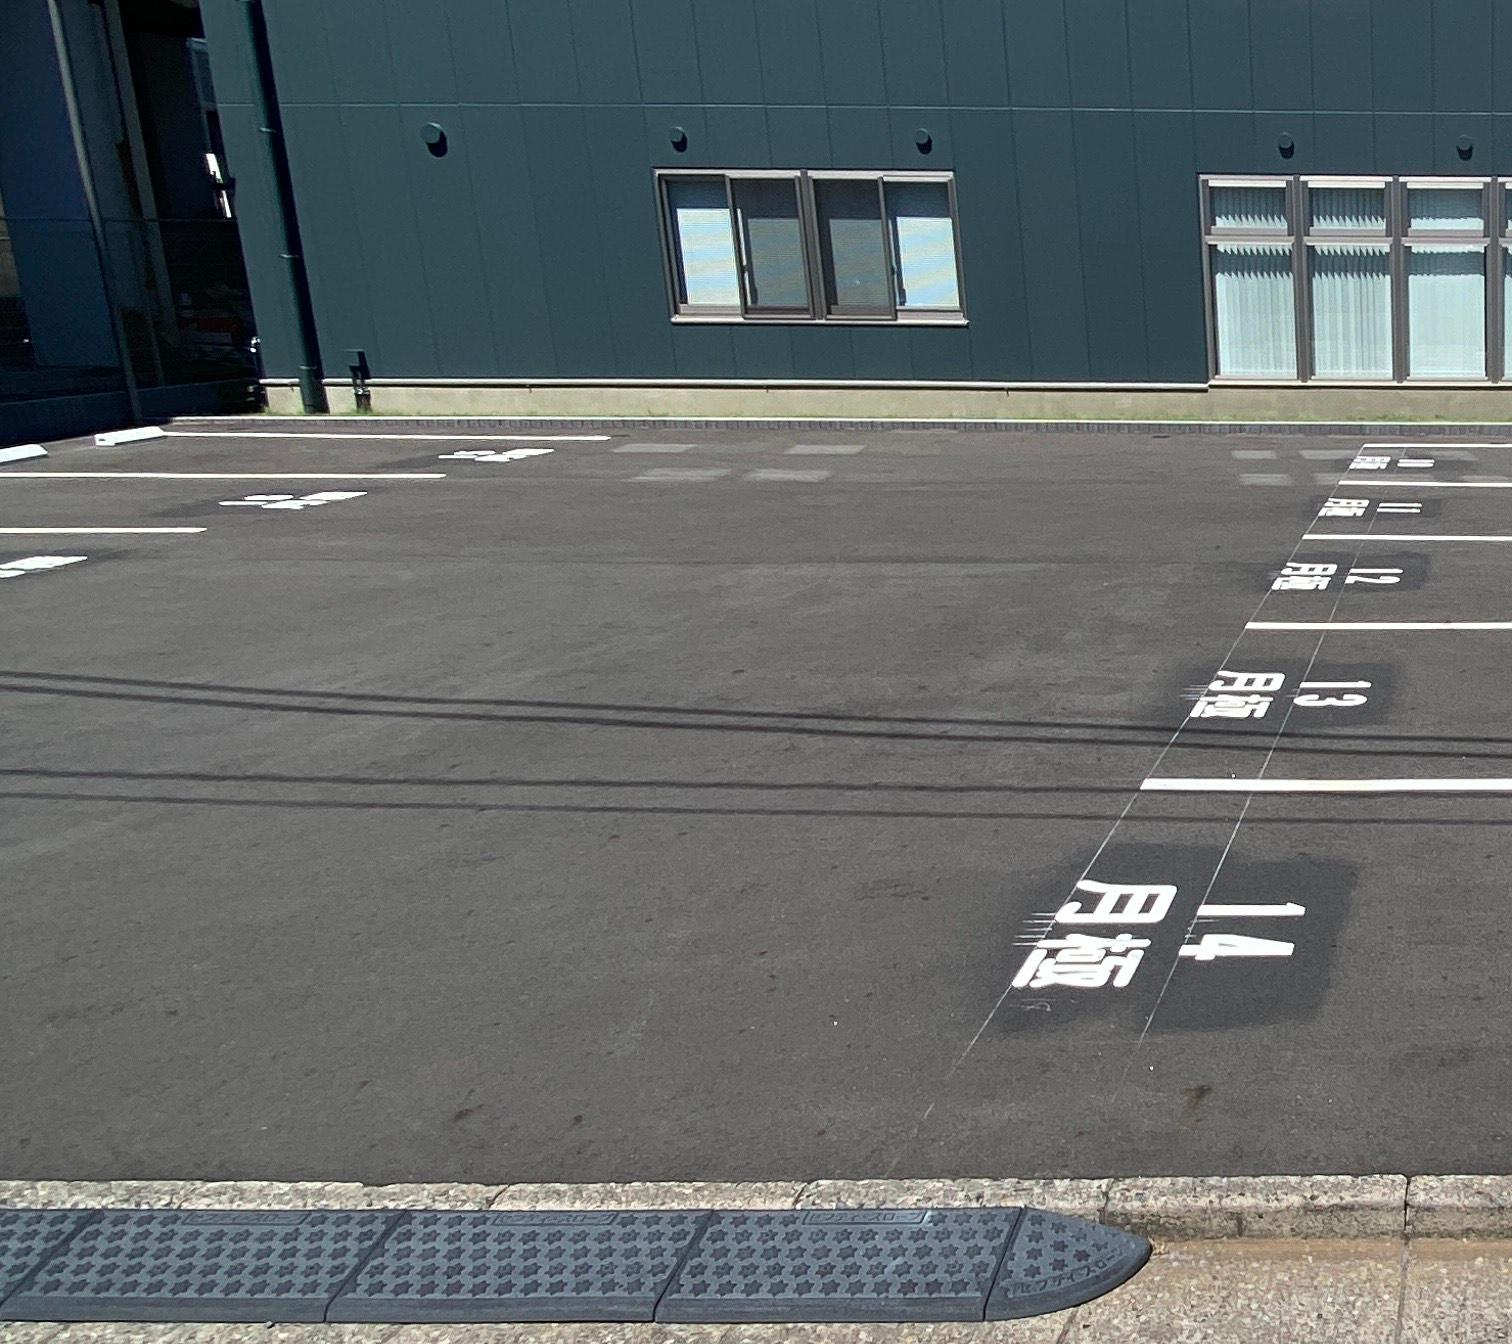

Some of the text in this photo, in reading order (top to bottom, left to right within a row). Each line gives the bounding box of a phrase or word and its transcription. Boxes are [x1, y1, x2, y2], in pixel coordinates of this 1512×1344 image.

[1271, 562, 1338, 591] 月極
[1344, 567, 1404, 585] 12
[1190, 670, 1286, 719] 月極
[1293, 680, 1373, 708] 13
[1012, 879, 1178, 988] 月極
[1179, 902, 1307, 961] 14
